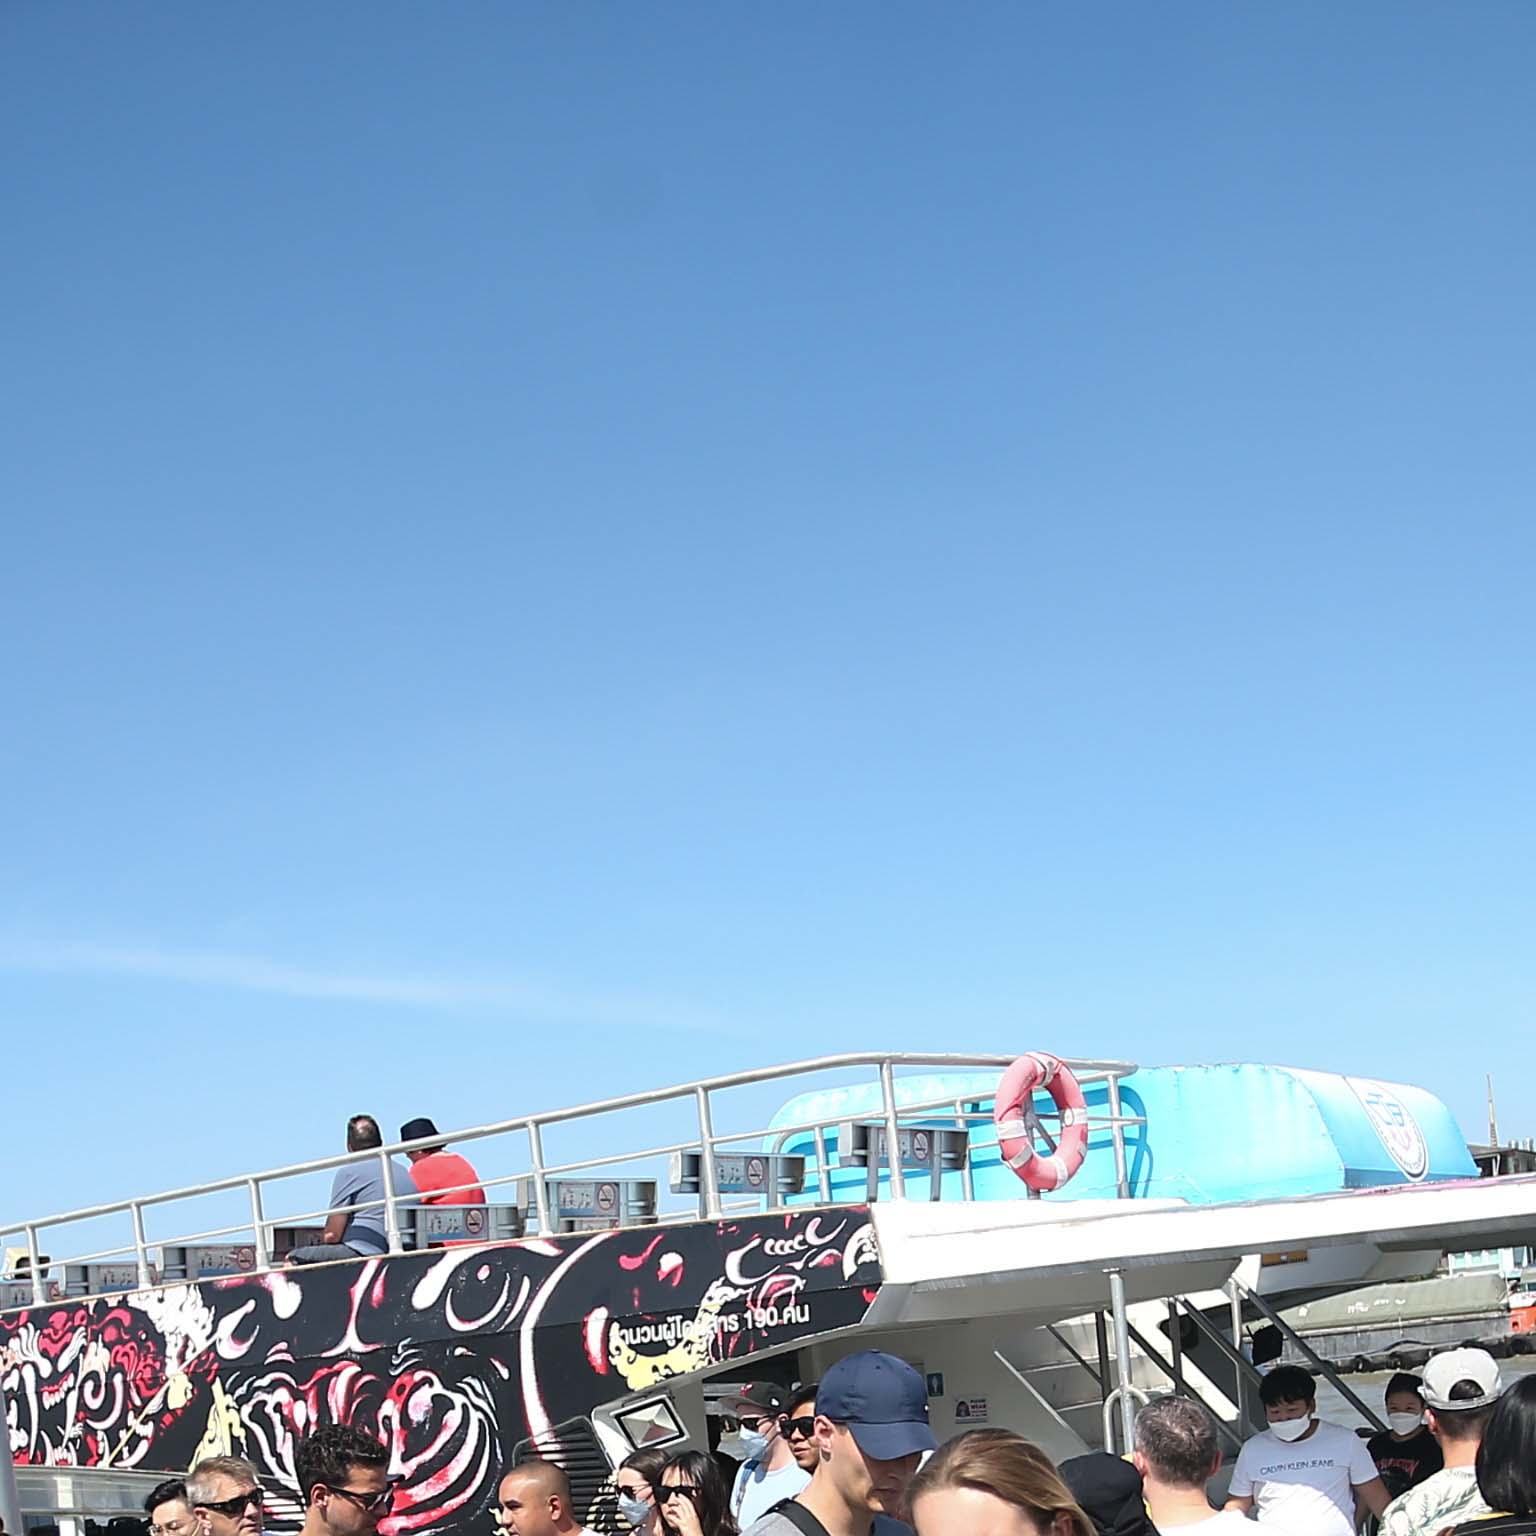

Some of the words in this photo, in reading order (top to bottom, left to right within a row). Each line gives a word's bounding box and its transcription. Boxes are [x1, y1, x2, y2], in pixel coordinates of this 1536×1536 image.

[744, 1307, 779, 1329] 190
[1260, 1463, 1287, 1476] CALVIN
[1287, 1461, 1309, 1472] KLEIN
